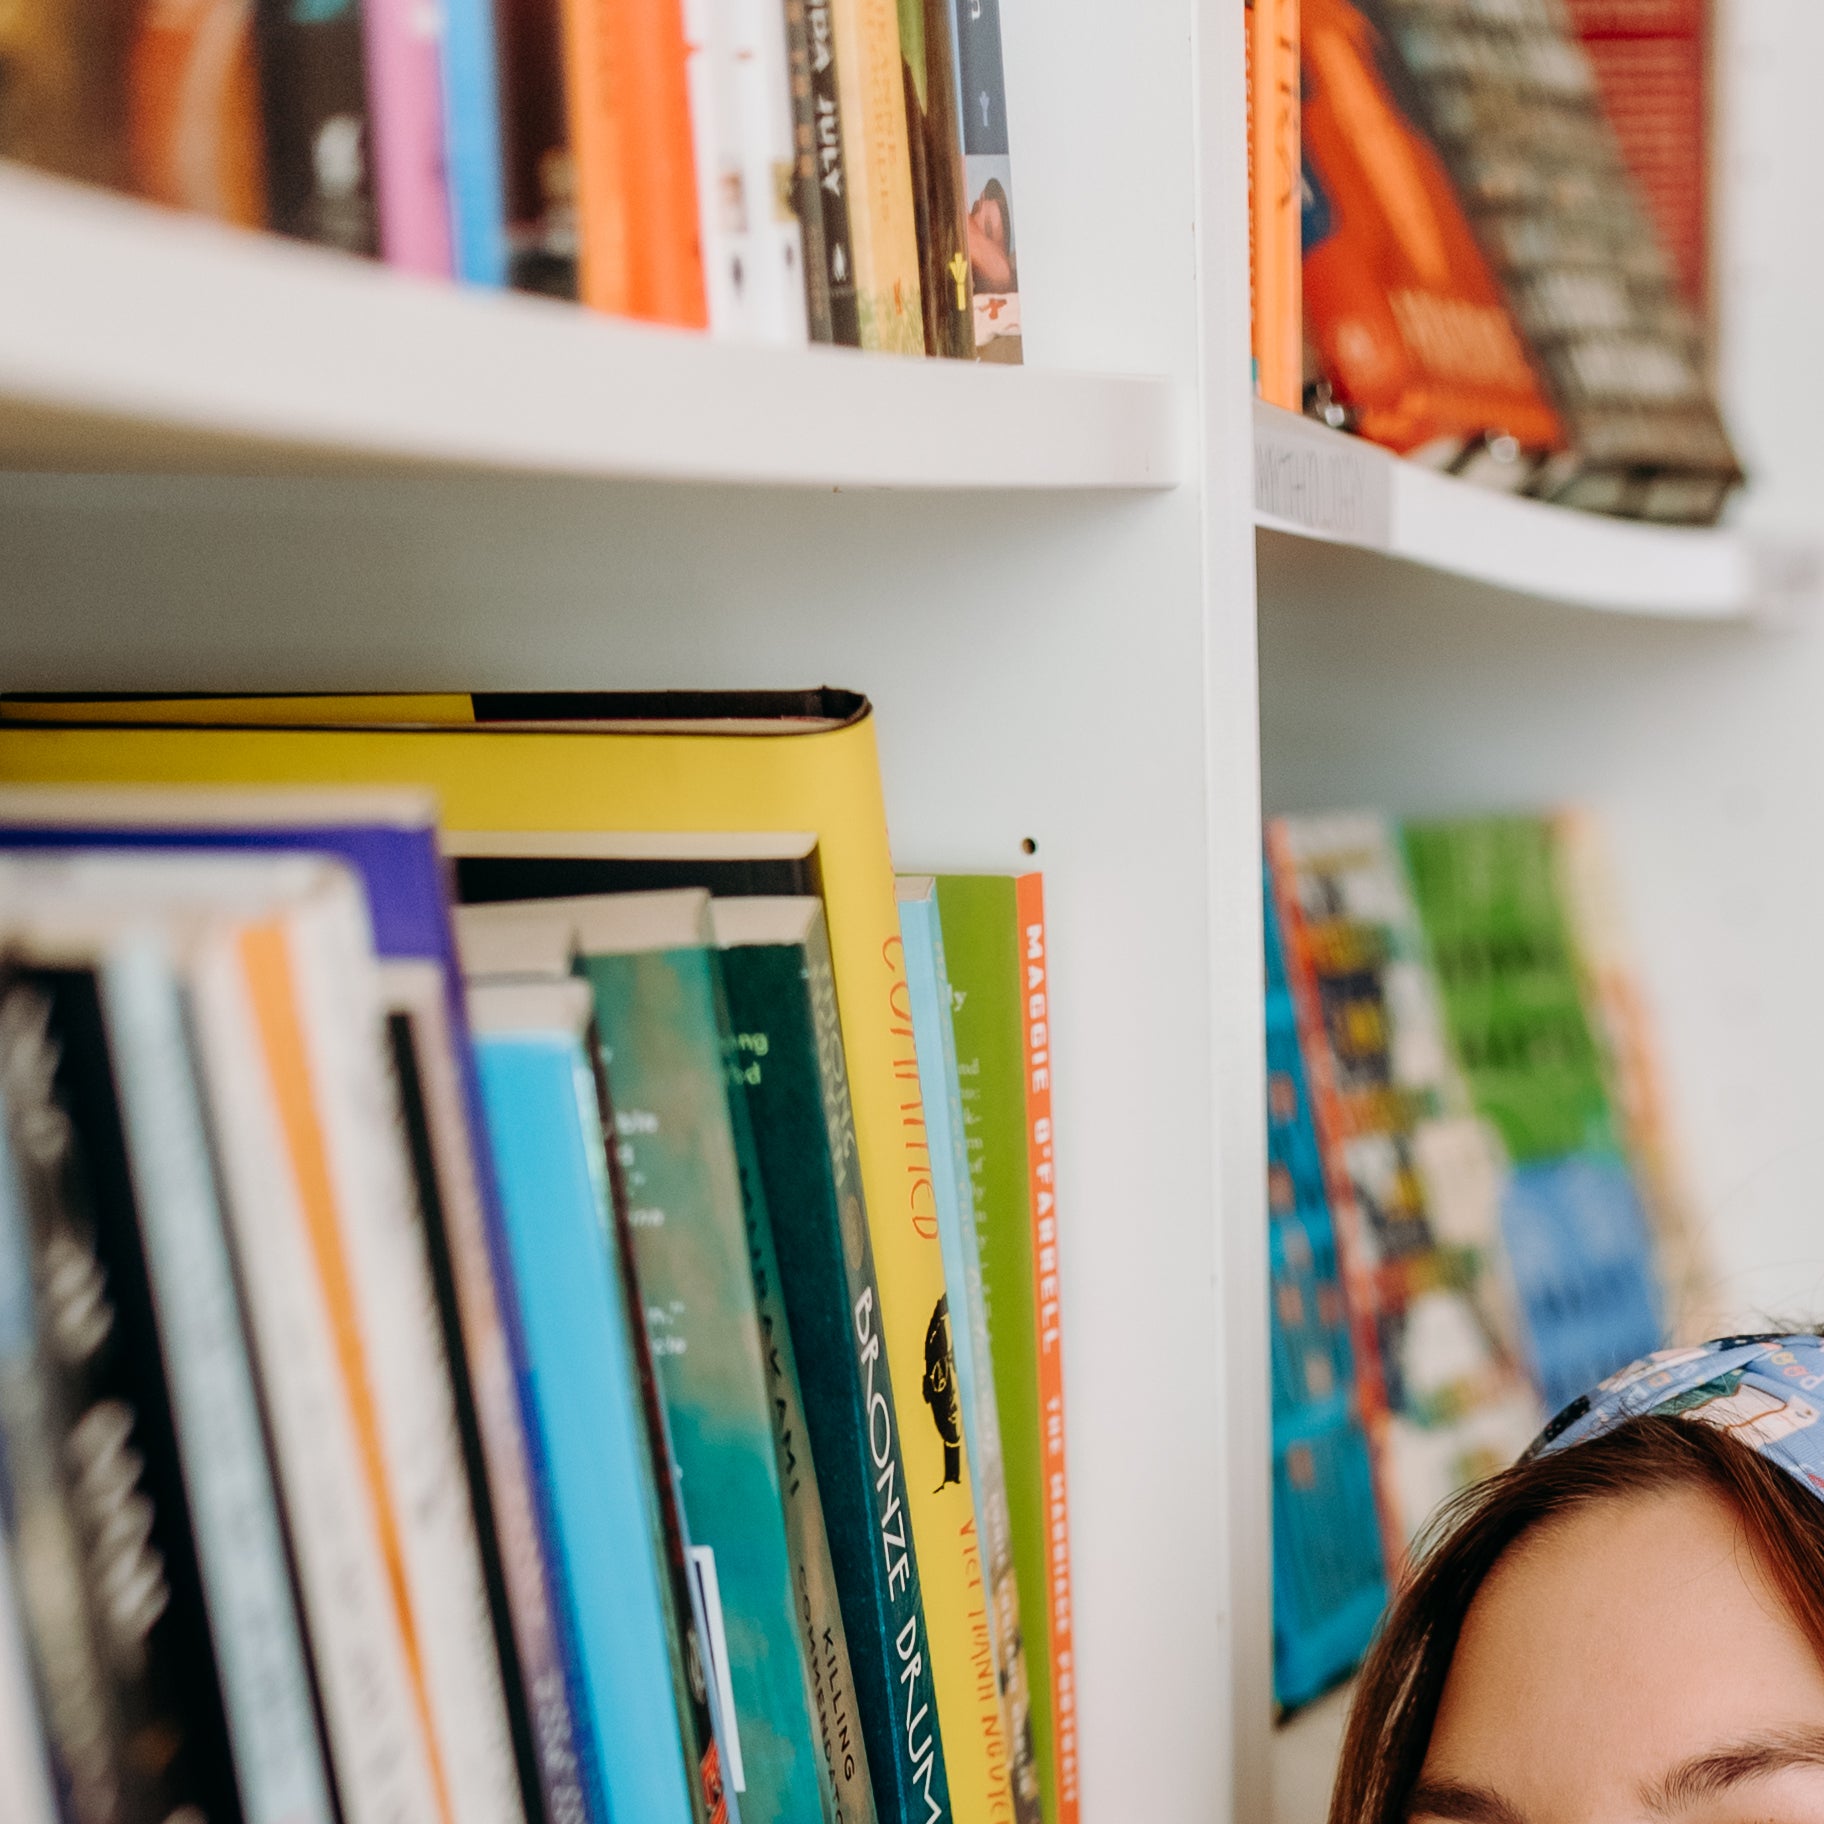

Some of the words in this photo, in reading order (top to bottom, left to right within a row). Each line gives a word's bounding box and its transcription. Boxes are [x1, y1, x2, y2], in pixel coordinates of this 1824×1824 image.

[1025, 923, 1049, 1093] MAGGIE
[1033, 1117, 1060, 1353] O'FARRELL
[854, 1286, 910, 1602] BRONZE
[1046, 1395, 1062, 1456] THE
[1050, 1471, 1072, 1635] MARRIAGE
[821, 1626, 856, 1784] KILLING
